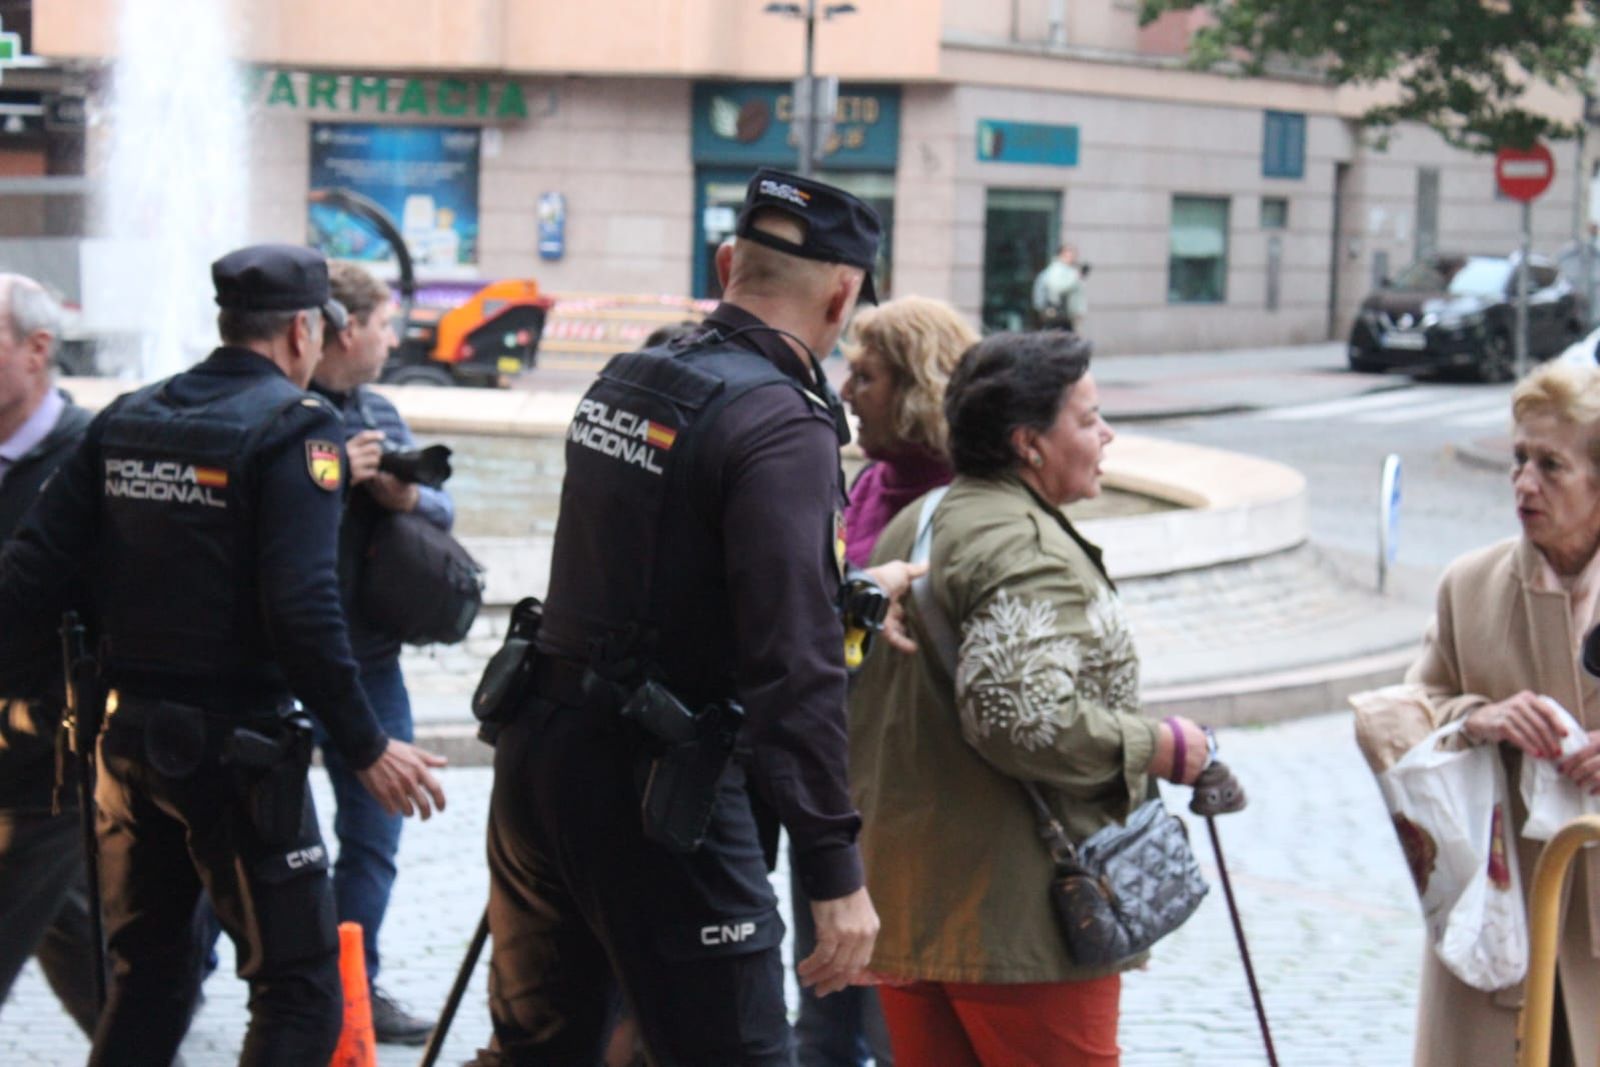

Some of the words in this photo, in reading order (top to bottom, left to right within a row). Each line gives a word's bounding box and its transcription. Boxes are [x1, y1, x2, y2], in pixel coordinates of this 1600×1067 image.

[576, 398, 650, 442] POLICIA
[570, 420, 663, 475] NACIONAL
[104, 459, 198, 484] POLICIA
[104, 479, 227, 508] NACIONAL
[286, 846, 322, 869] CNP
[701, 922, 756, 945] CNP
